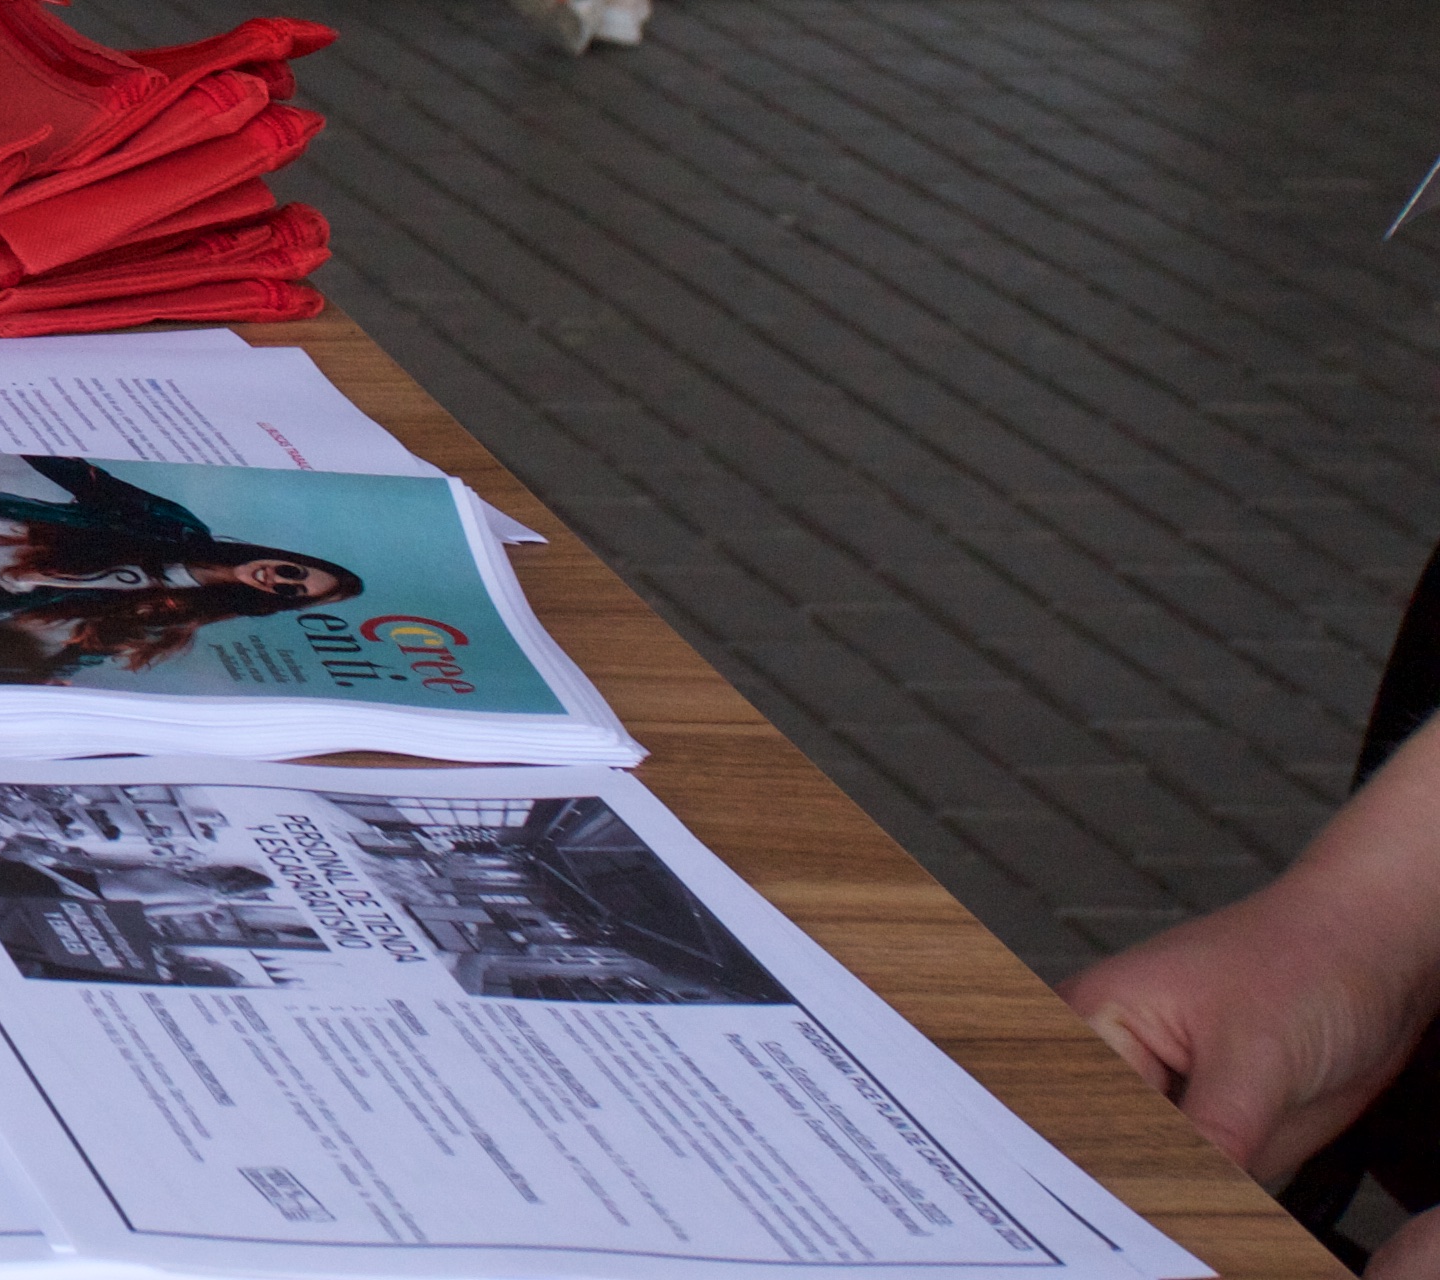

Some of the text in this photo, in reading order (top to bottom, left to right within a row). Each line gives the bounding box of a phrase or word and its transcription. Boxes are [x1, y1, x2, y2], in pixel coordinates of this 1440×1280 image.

[296, 612, 409, 688] en ti.
[358, 613, 477, 695] Cree
[245, 824, 282, 835] Y
[252, 836, 374, 949] ESCAPARATISMO
[276, 813, 428, 963] PERSONAL DE TIENDA
